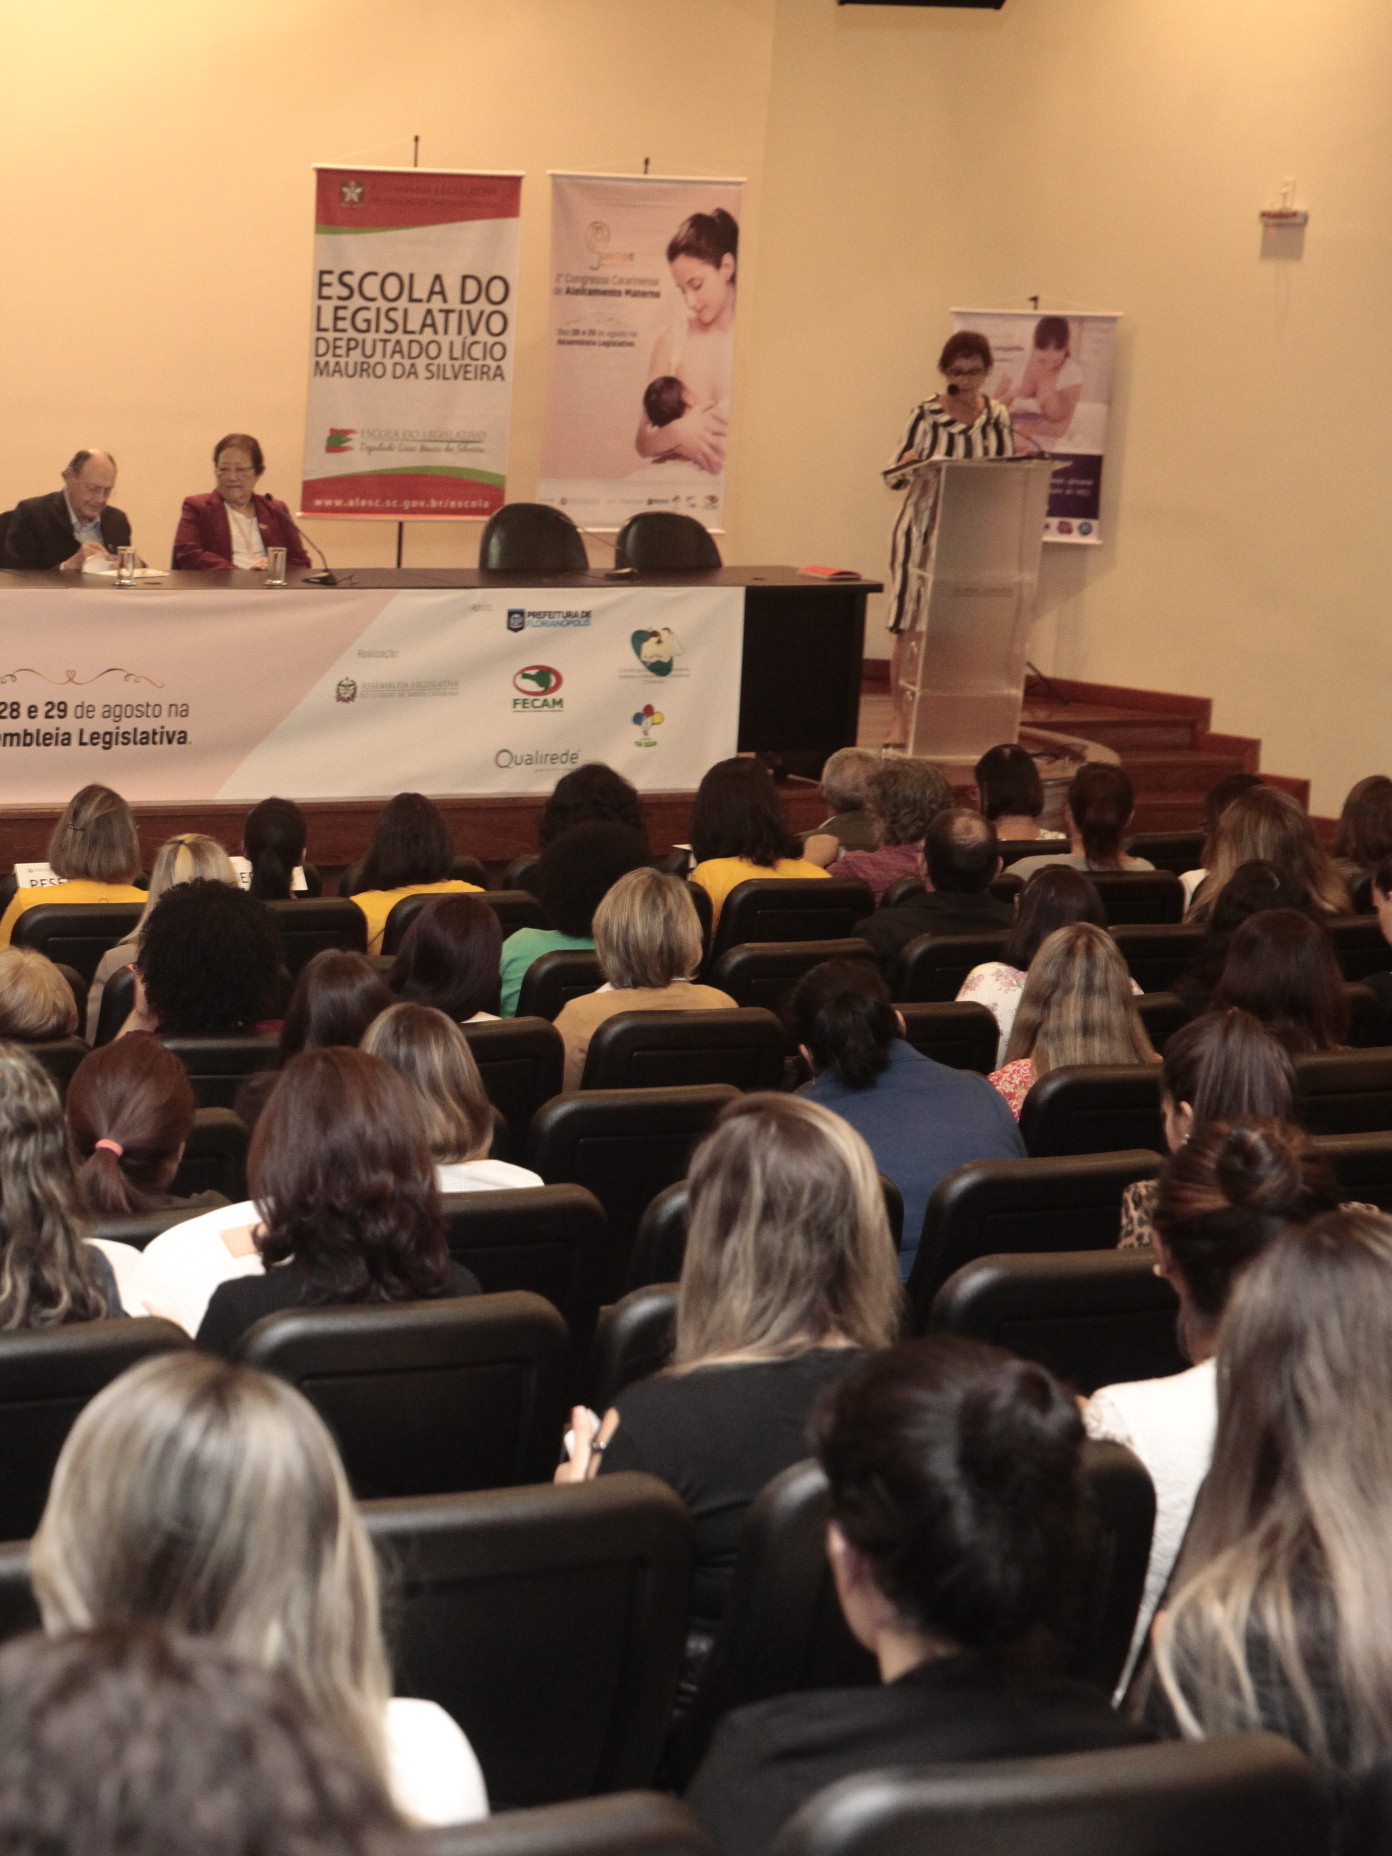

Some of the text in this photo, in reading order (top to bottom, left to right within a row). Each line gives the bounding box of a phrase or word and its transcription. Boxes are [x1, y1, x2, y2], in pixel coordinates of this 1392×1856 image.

[316, 270, 511, 306] ESCOLA DO
[315, 304, 509, 337] LEGISLATIVO
[314, 335, 508, 362] DEPUTADO LÍCIO
[313, 360, 505, 382] MAURO DA SILVEIRA
[527, 610, 579, 619] PREFEITURA
[28, 705, 38, 719] e
[44, 700, 67, 719] 29
[74, 700, 95, 719] de
[102, 701, 162, 722] agosto
[167, 703, 189, 718] na
[512, 698, 564, 709] FECAM
[495, 748, 580, 768] Qualirede
